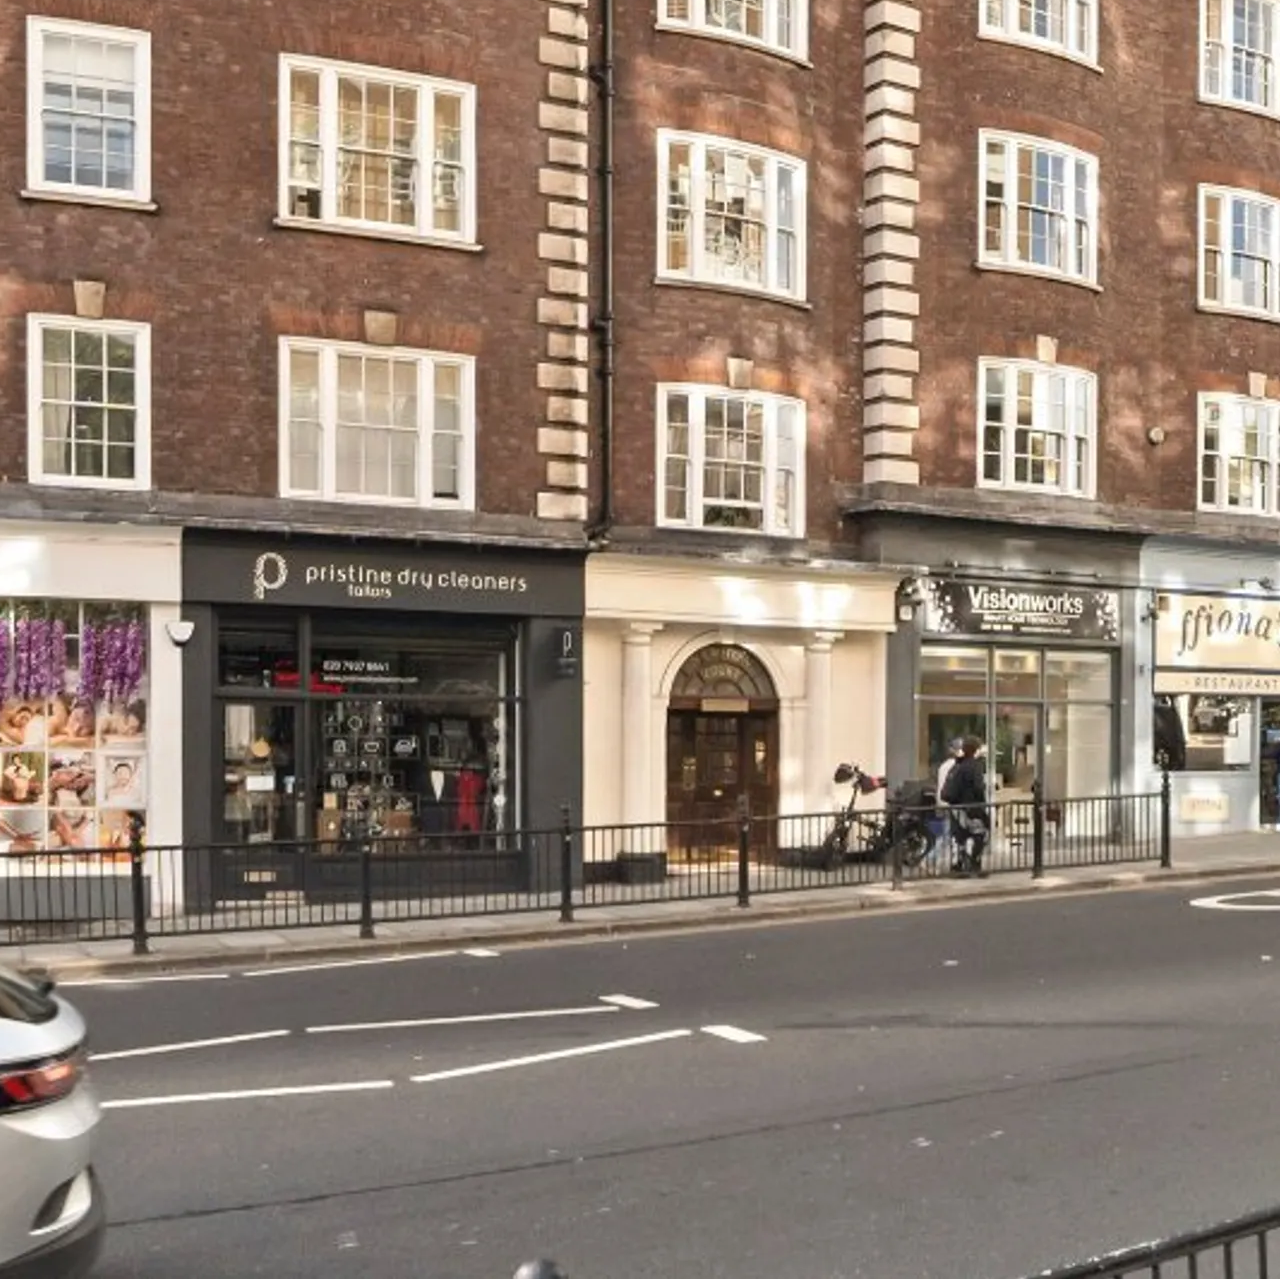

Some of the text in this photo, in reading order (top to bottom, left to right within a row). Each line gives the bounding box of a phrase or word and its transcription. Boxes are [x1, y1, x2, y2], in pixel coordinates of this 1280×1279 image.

[305, 564, 527, 592] pristine dry cleaners
[347, 583, 391, 599] tailors
[969, 586, 1083, 614] Visionworks
[1195, 677, 1278, 690] RESTAURANT
